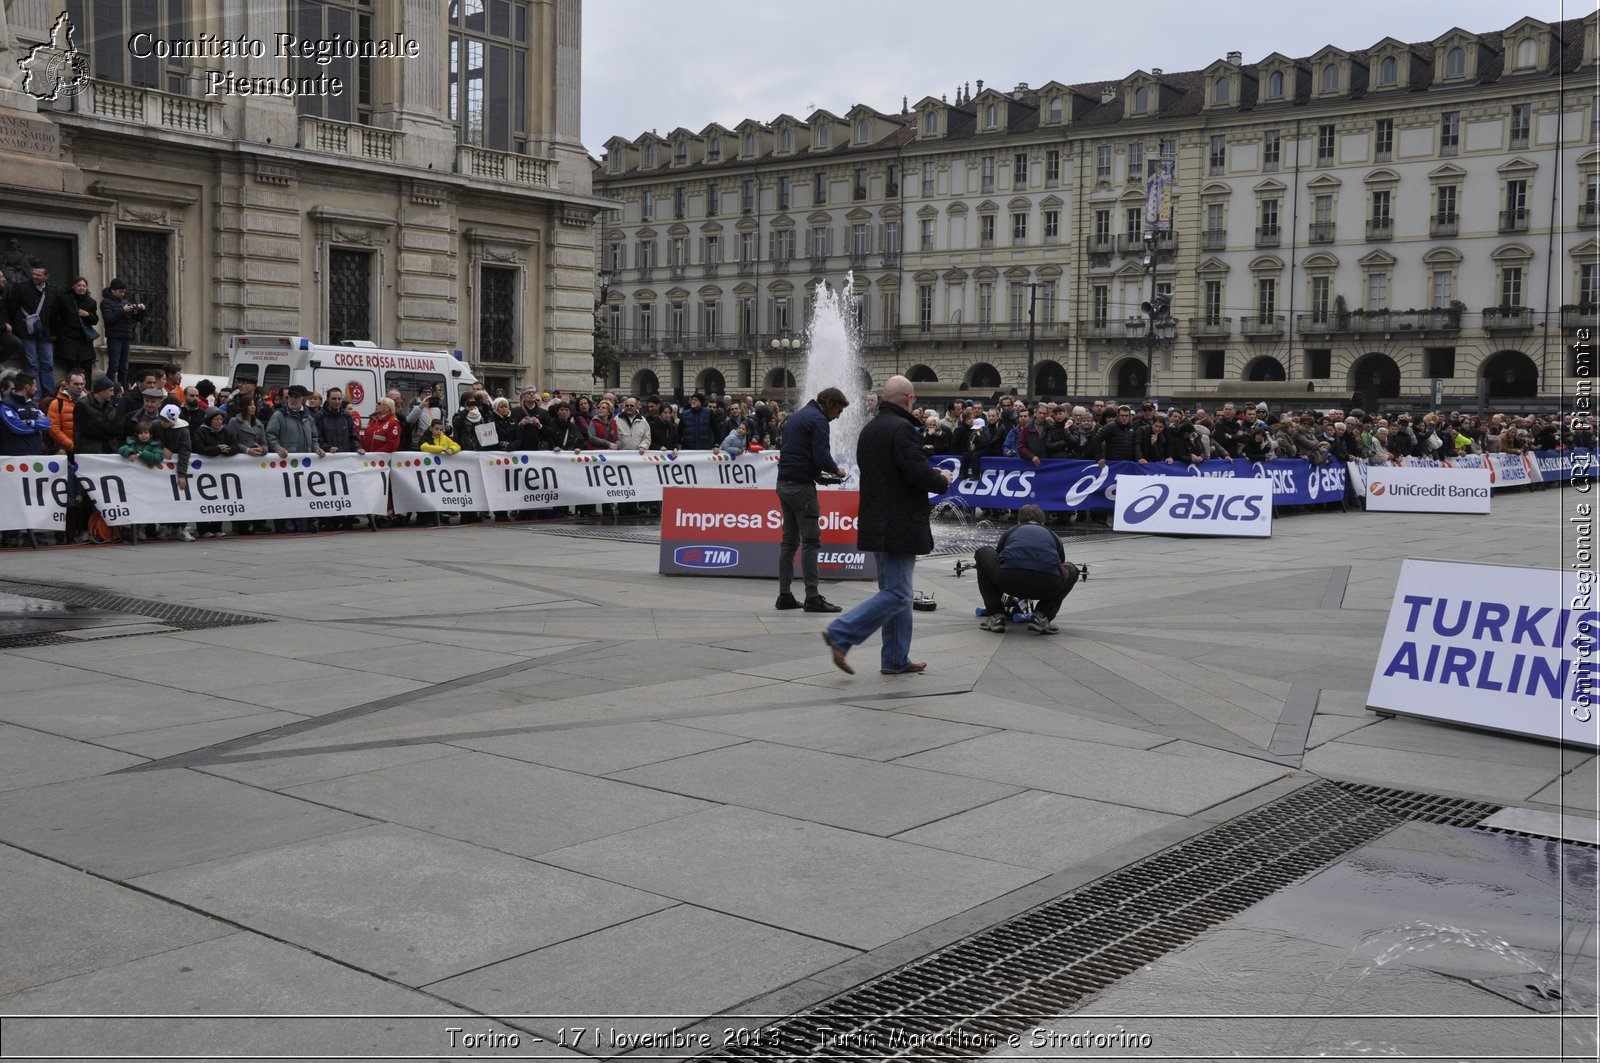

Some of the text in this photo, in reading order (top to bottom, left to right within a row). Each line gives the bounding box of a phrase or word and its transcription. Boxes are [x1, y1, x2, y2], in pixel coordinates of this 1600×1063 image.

[21, 130, 55, 143] SARDO
[335, 353, 436, 371] CROCE ROSSA ITALIANA
[1497, 455, 1522, 467] TURKISH
[416, 468, 471, 494] iren
[505, 466, 559, 492] iren
[585, 464, 633, 487] iren
[656, 464, 697, 485] iren
[718, 463, 757, 484] iren
[1502, 468, 1526, 480] AIRLINES
[283, 470, 349, 497] iren
[1389, 483, 1488, 498] UniCredit Banca
[22, 477, 67, 507] ire
[523, 491, 559, 504] energia
[607, 487, 636, 498] energia
[309, 497, 351, 511] energia
[442, 494, 473, 507] energia
[200, 501, 245, 516] energia
[676, 509, 762, 531] Impresa
[704, 551, 731, 564] TIM
[817, 552, 865, 564] ELECOM
